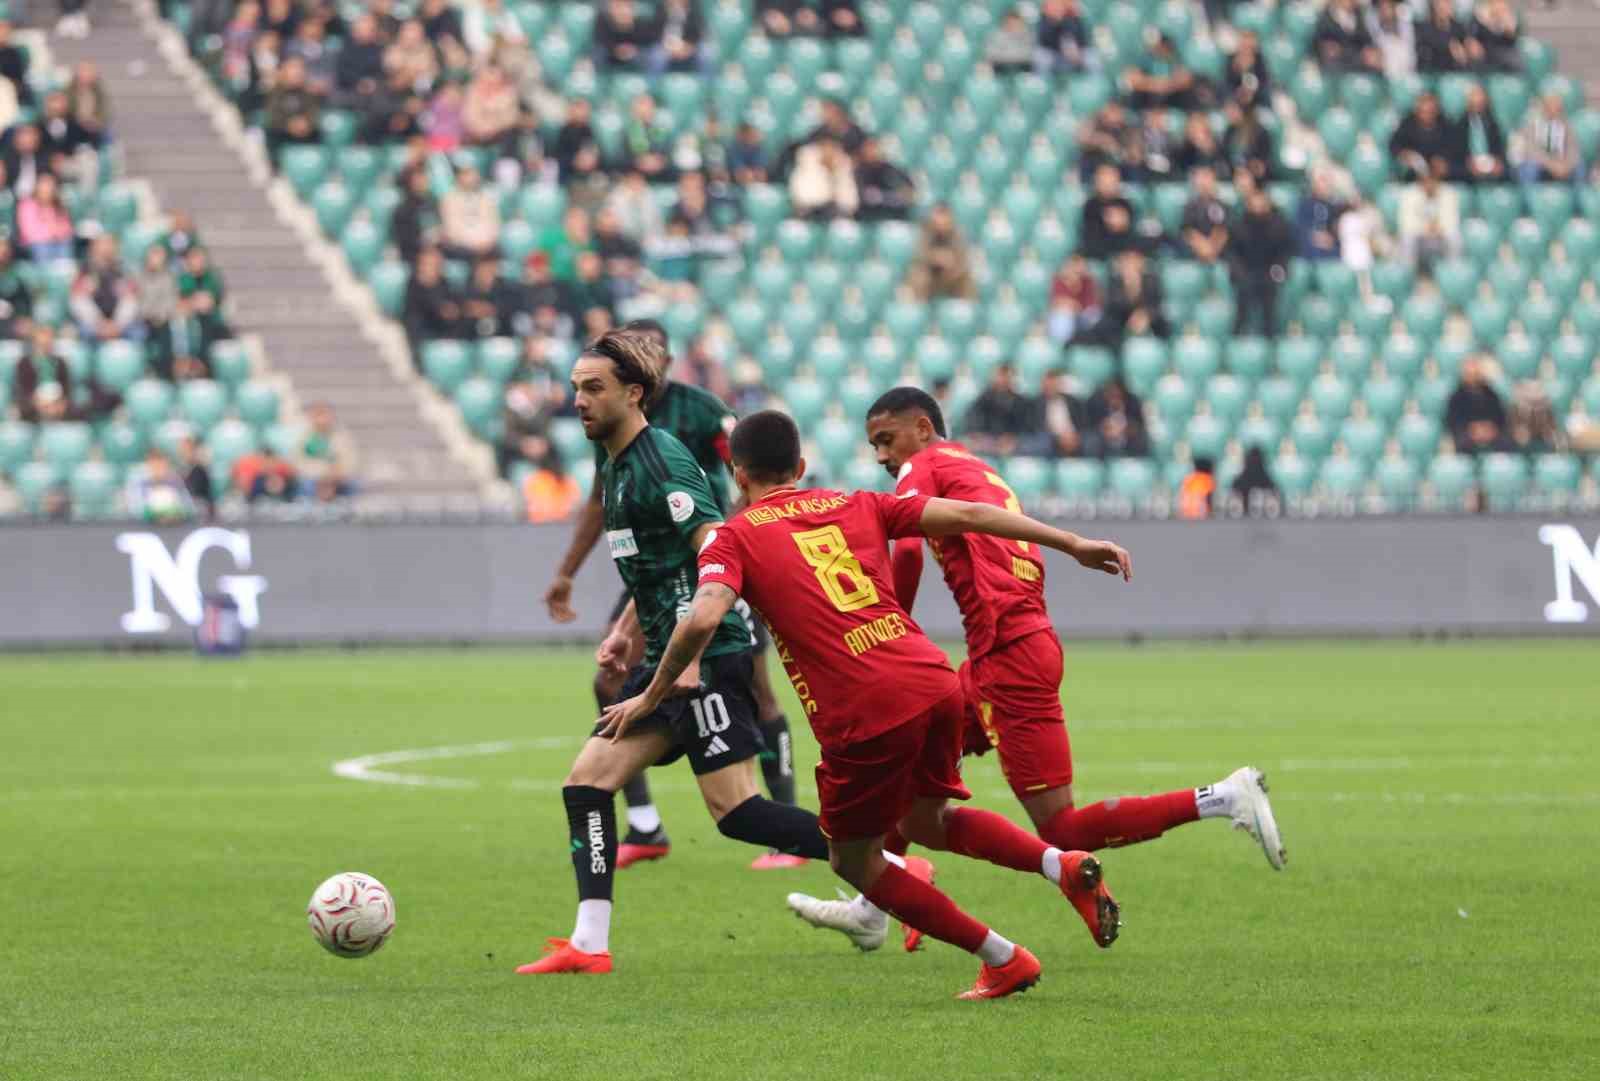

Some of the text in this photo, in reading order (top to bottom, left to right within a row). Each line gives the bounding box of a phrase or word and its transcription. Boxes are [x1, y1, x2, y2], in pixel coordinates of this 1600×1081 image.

[115, 526, 268, 634] NG
[791, 525, 881, 613] 8
[689, 692, 731, 739] 10
